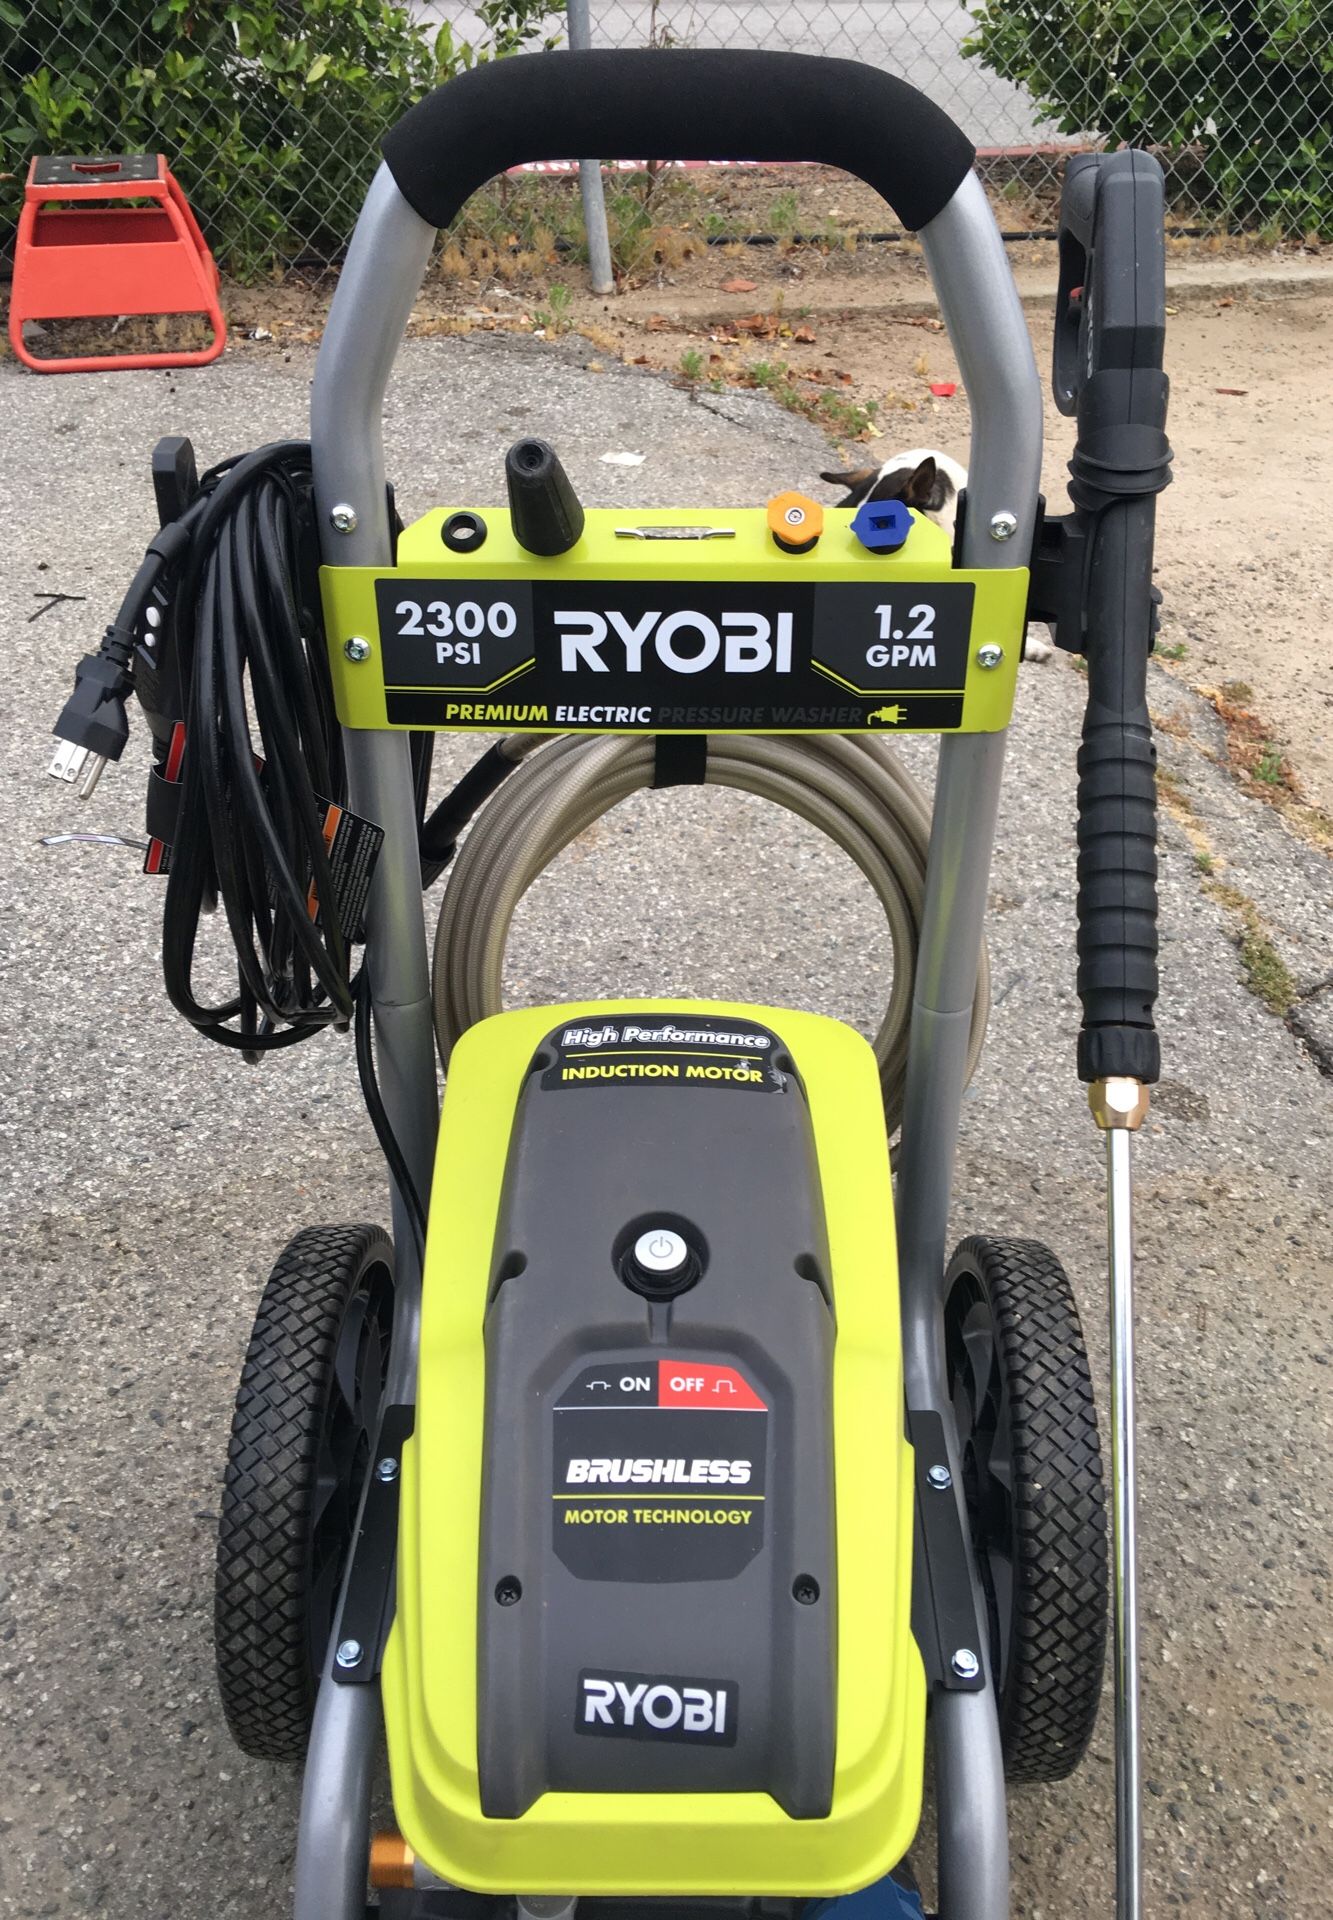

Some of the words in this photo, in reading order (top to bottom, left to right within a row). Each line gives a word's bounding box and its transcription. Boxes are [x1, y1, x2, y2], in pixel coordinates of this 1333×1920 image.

[395, 600, 517, 638] 2300
[873, 603, 936, 640] 1.2
[435, 642, 482, 665] PSI
[553, 610, 794, 673] RYOBI
[865, 644, 937, 668] GPM
[445, 703, 549, 722] PREMIUM
[554, 705, 652, 724] ELECTRIC
[656, 706, 764, 725] PRESSURE
[771, 706, 863, 726] WASHER
[561, 1026, 618, 1047] High
[622, 1026, 771, 1050] Performance
[562, 1064, 679, 1081] INDUCTION
[685, 1065, 764, 1083] MOTOR
[619, 1377, 650, 1391] ON
[670, 1377, 704, 1391] OFF
[566, 1459, 752, 1484] BRUSHLESS
[564, 1509, 628, 1524] MOTOR
[633, 1509, 752, 1524] TECHNOLOGY
[583, 1679, 727, 1733] RYOBI
